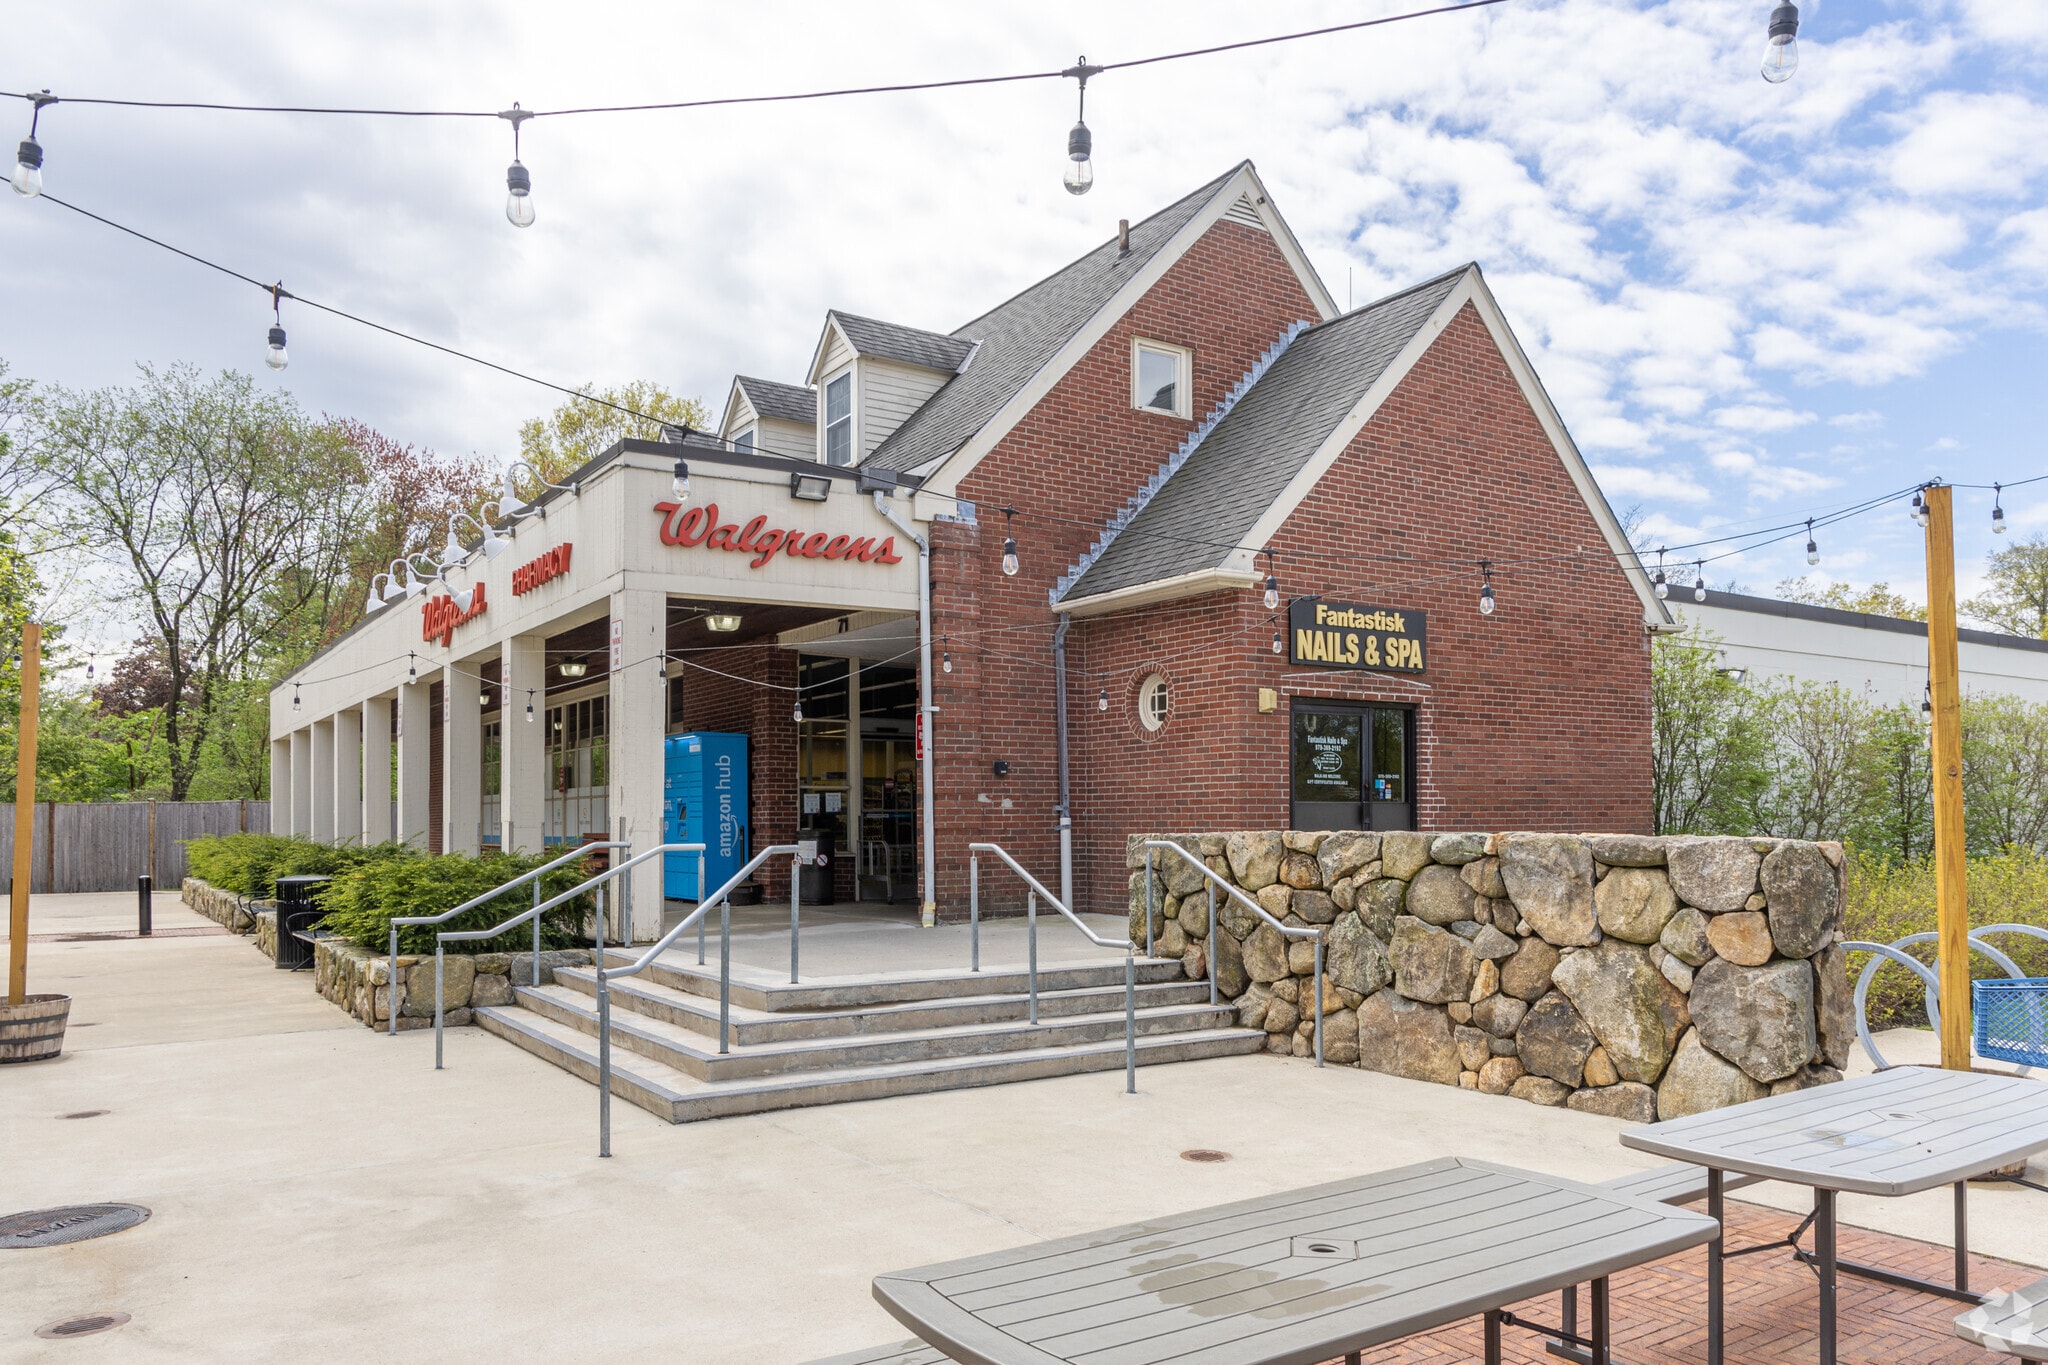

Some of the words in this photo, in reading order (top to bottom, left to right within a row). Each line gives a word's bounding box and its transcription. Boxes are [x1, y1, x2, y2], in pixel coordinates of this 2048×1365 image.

[654, 501, 903, 568] Walgreens
[512, 543, 573, 597] PHARMACY
[1316, 604, 1406, 633] Fantastisk
[1297, 629, 1360, 664] NAILS
[1365, 635, 1380, 666] &
[1385, 637, 1423, 669] SPA
[715, 755, 731, 789] hub
[720, 794, 732, 857] amazon
